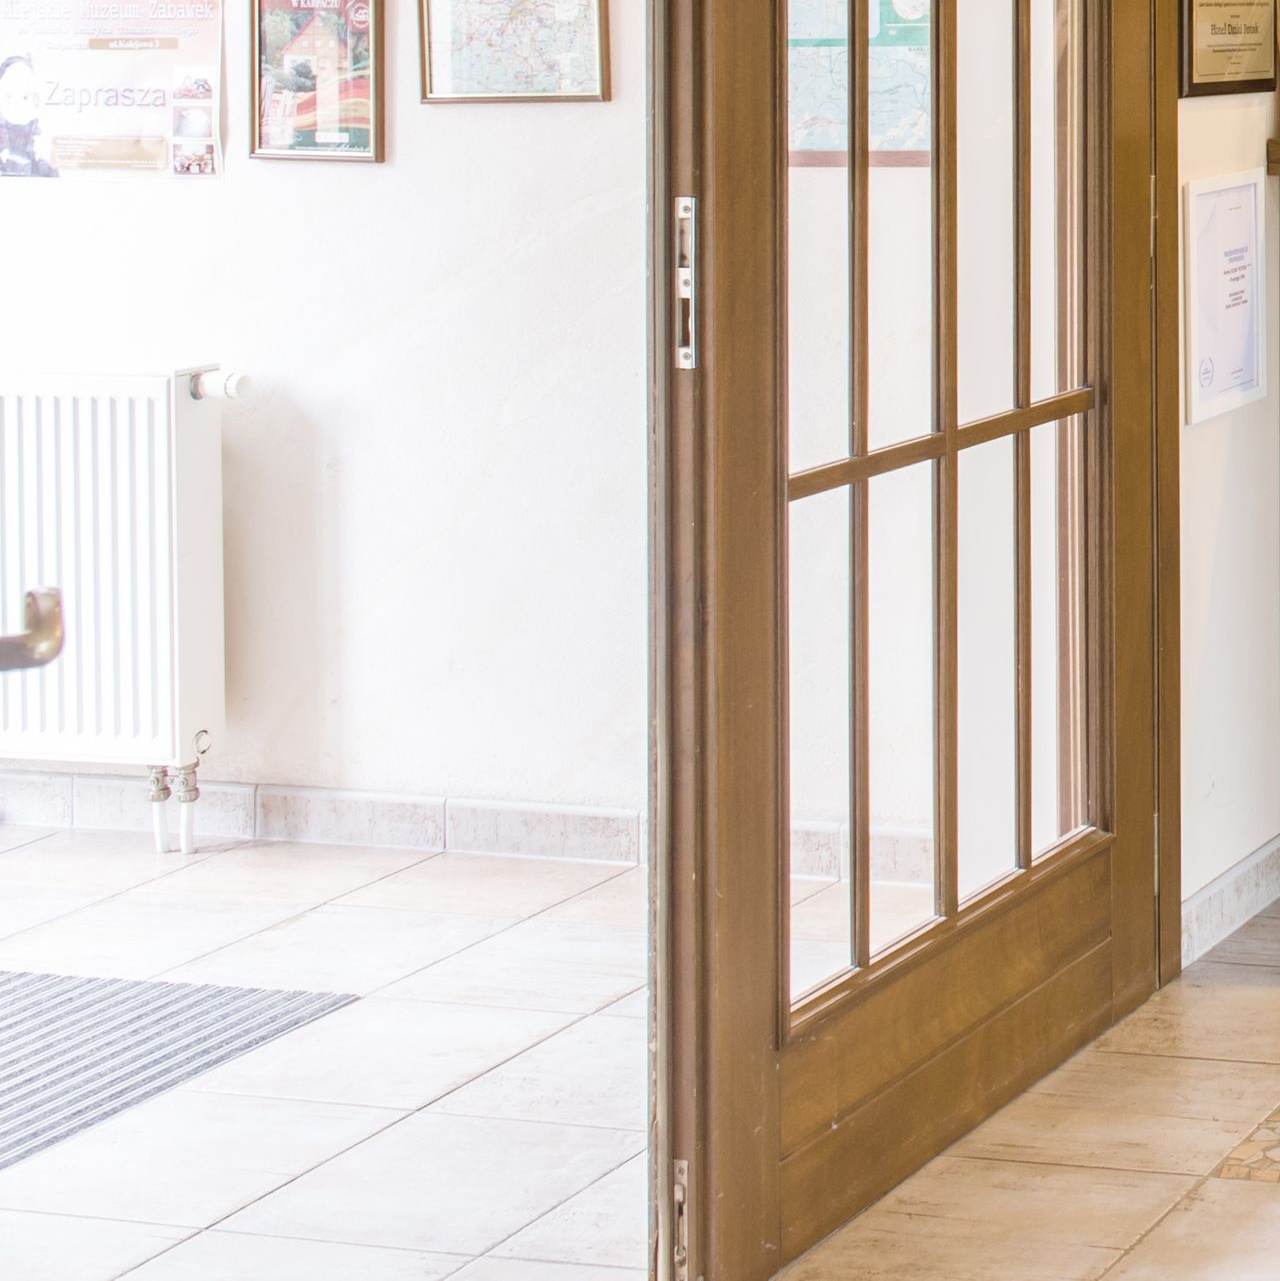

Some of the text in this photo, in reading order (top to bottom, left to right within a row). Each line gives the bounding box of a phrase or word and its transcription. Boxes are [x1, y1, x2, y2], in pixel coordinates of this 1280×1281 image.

[291, 0, 299, 8] W
[1210, 22, 1260, 36] Hotel Dziki Potok
[45, 79, 167, 113] Zaprasza
